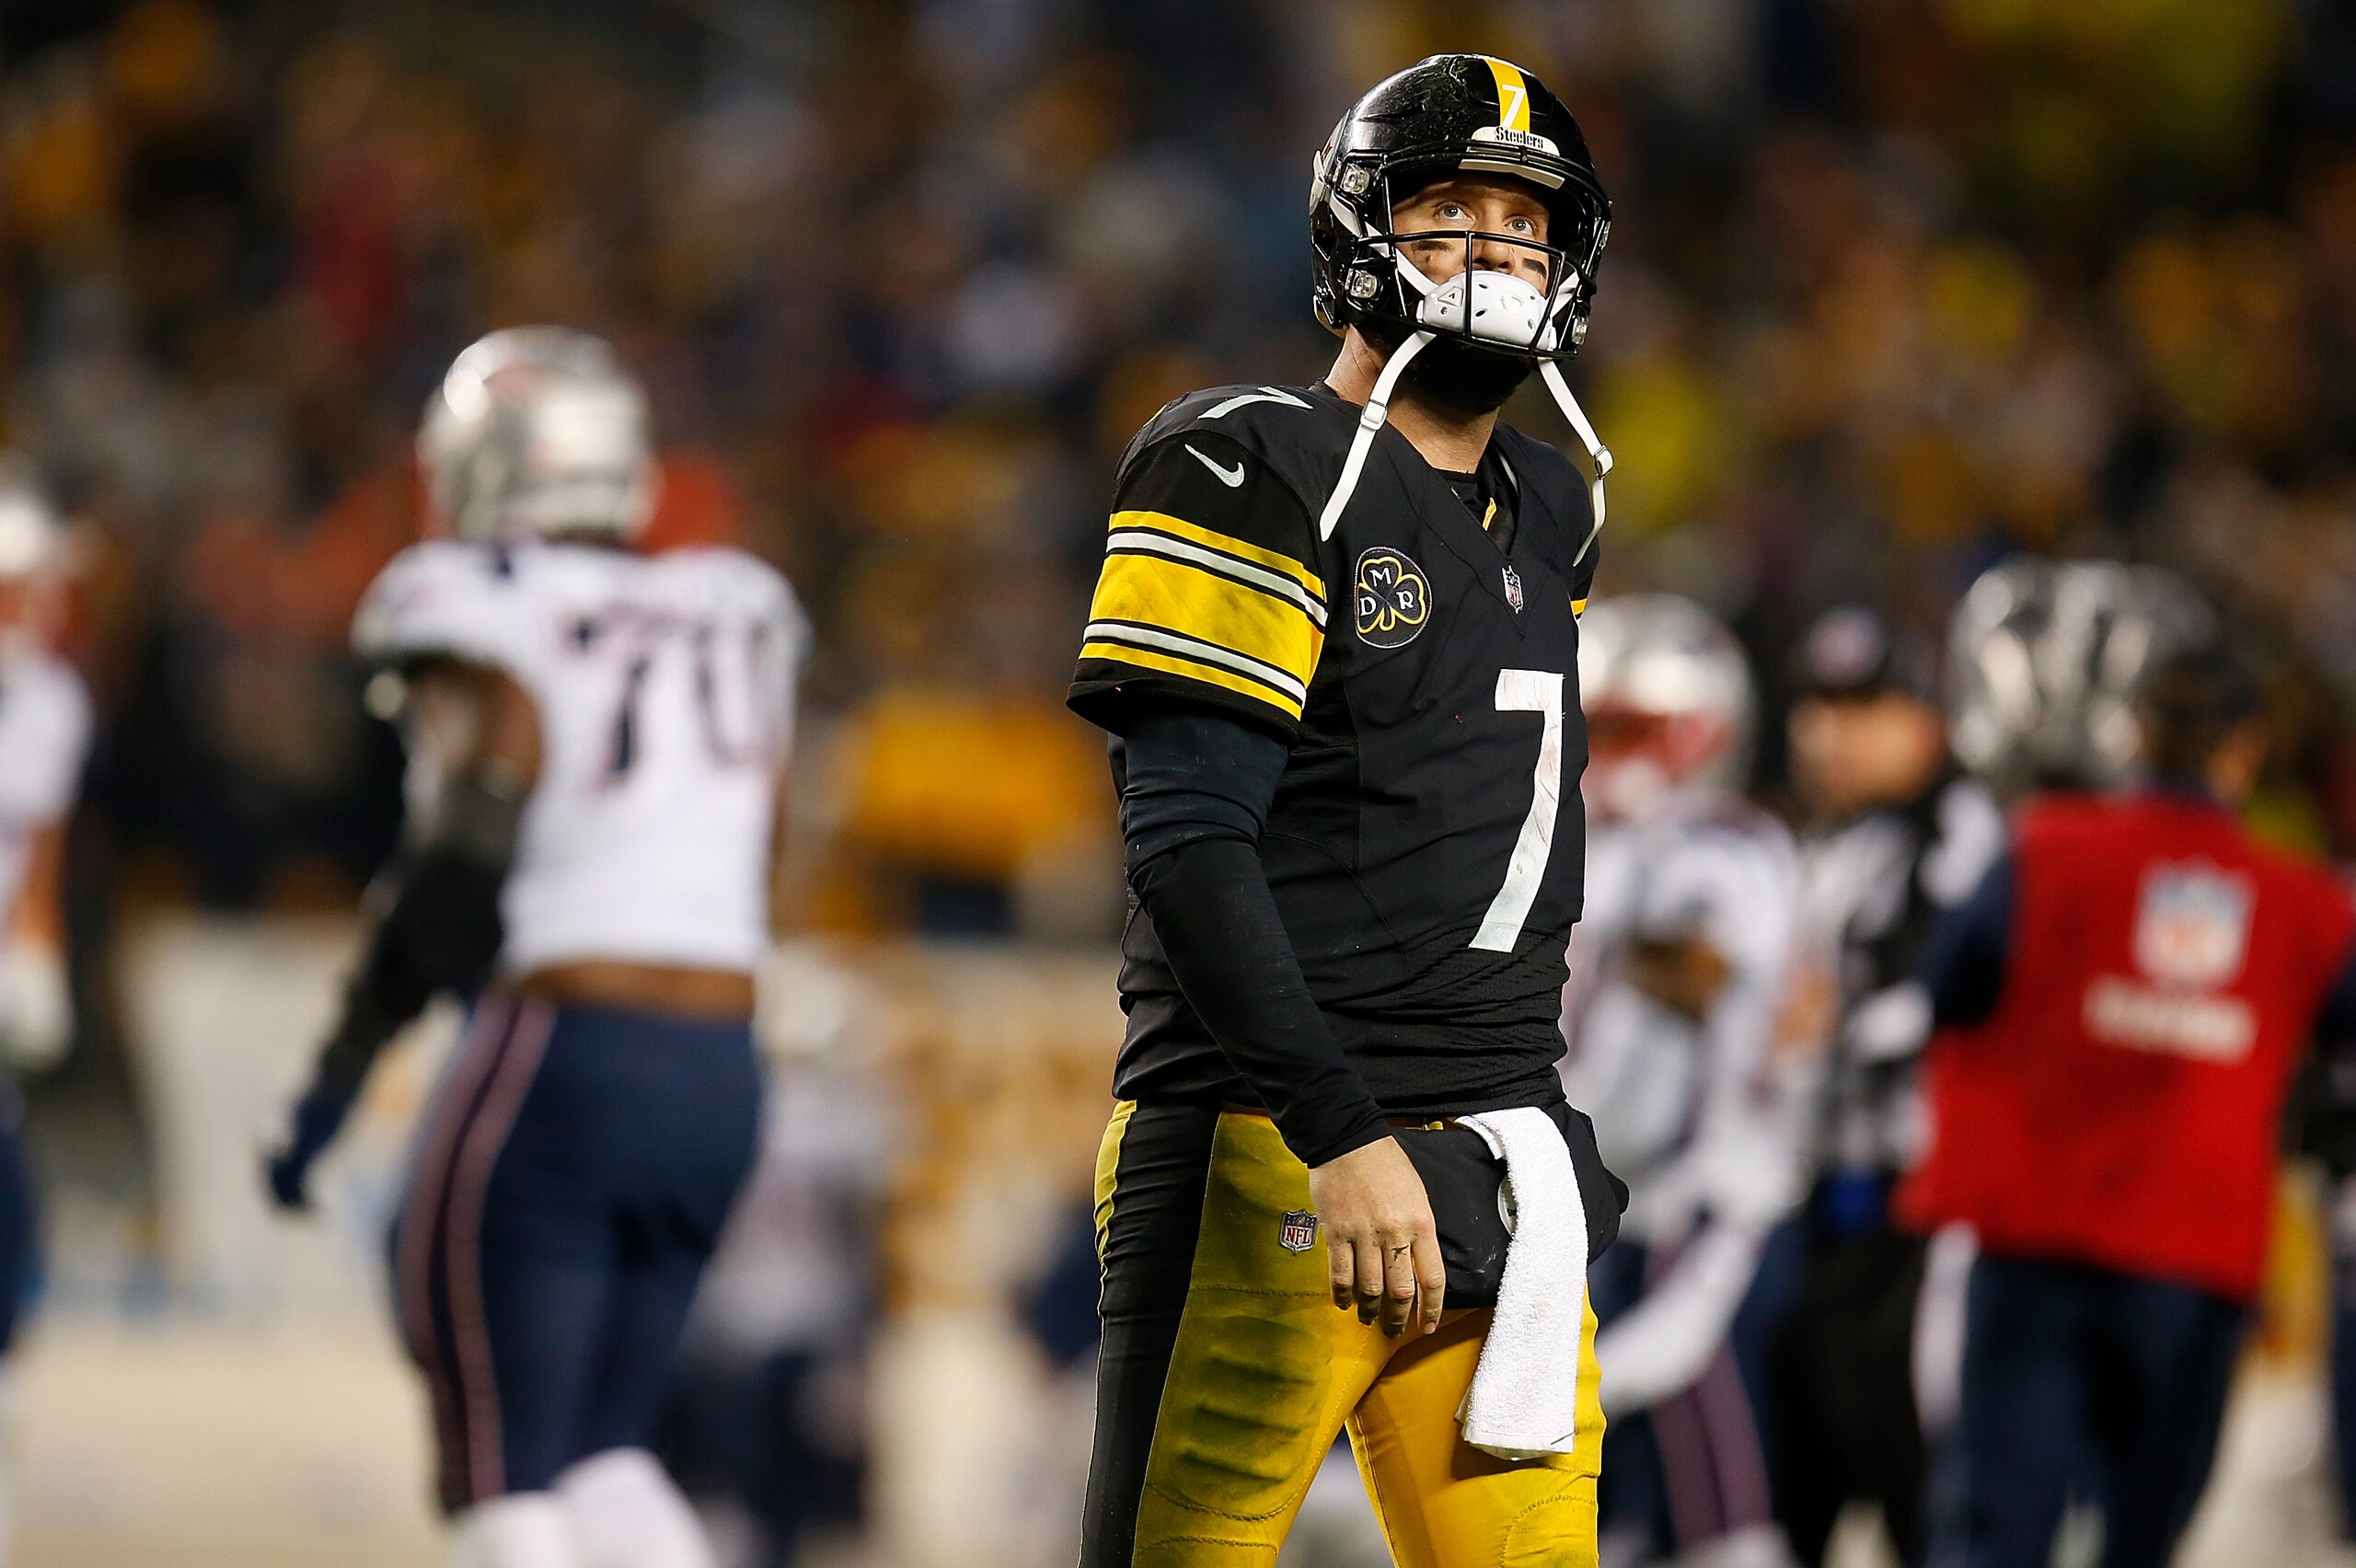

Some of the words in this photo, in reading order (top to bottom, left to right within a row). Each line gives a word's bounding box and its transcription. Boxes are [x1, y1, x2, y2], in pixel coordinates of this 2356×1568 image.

[1501, 84, 1526, 130] 7
[1494, 126, 1543, 149] Steelers
[1370, 567, 1392, 586] M
[1468, 668, 1564, 953] 7
[1286, 1227, 1311, 1246] NFL
